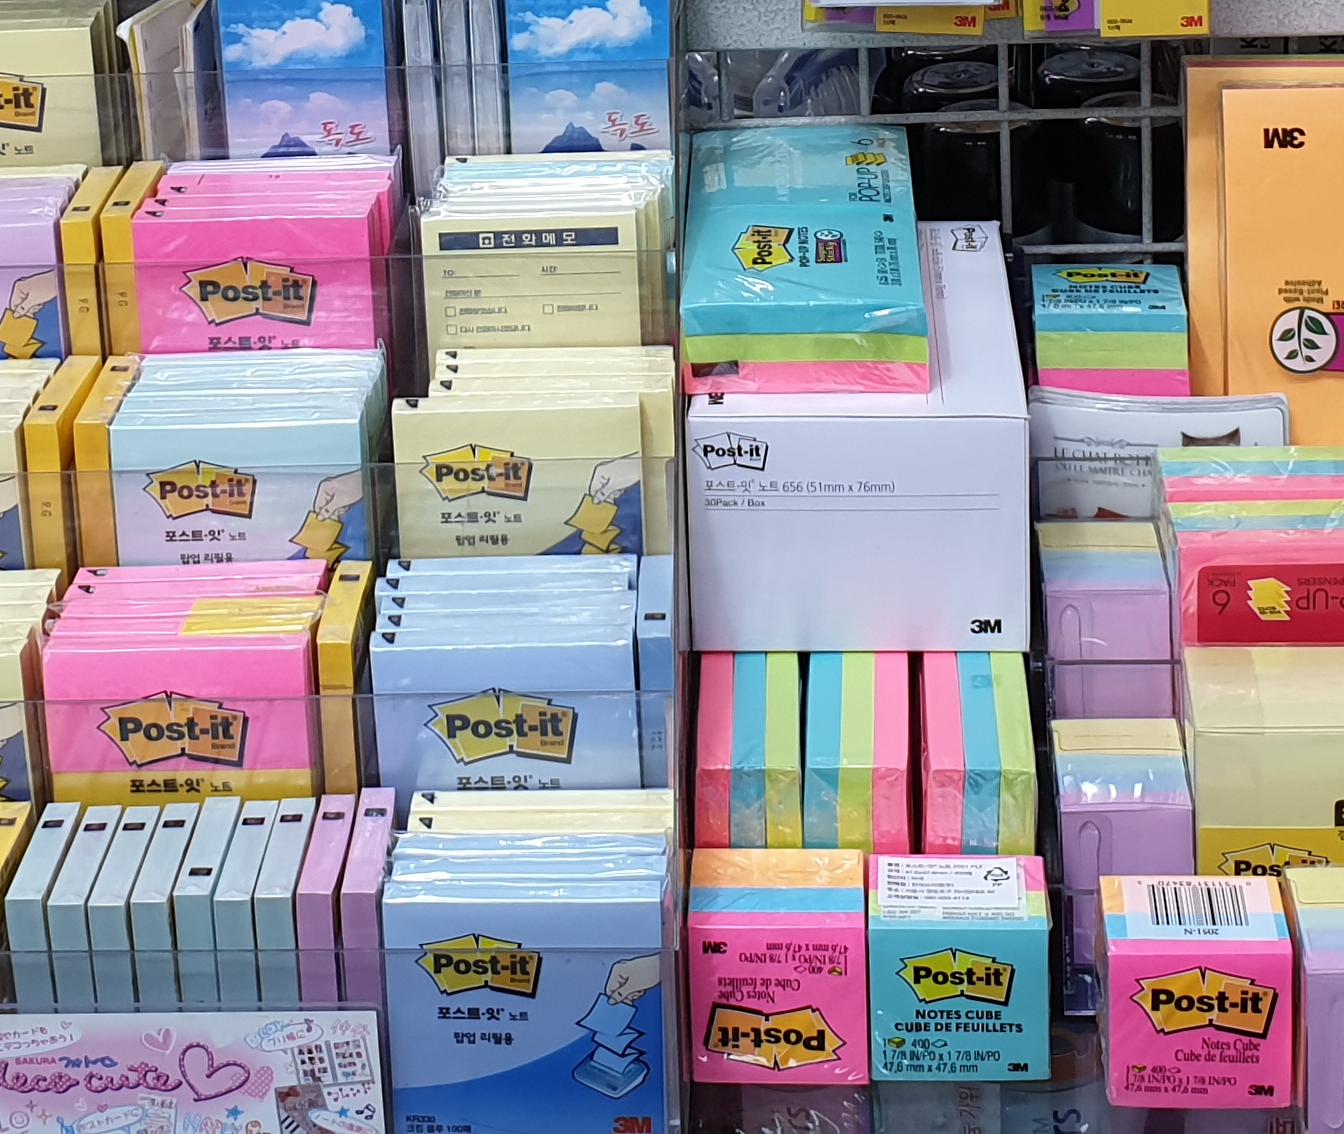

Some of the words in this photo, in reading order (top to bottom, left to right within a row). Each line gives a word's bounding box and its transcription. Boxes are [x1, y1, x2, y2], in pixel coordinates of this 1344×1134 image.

[602, 111, 658, 141] 독도
[319, 121, 375, 147] 독도
[1263, 127, 1306, 149] 3M
[14, 146, 34, 155] 노트
[502, 232, 576, 246] 전화메모
[758, 480, 779, 493] 노트
[782, 481, 803, 493] 656
[806, 480, 844, 494] (51mm
[848, 484, 854, 492] x
[856, 480, 895, 494] 76mm)
[509, 1011, 529, 1021] 노트
[916, 1010, 961, 1019] NOTES
[965, 1010, 1001, 1019] CUBE
[895, 1023, 930, 1031] CUBE
[935, 1023, 951, 1032] DE
[956, 1023, 1023, 1032] FEUILLETS
[454, 1032, 475, 1044] 팝업
[480, 1032, 514, 1045] 리필용
[1202, 1038, 1230, 1051] Notes
[1234, 1039, 1260, 1051] Cube
[15, 1057, 56, 1065] SAKURA
[892, 1051, 906, 1060] 7/8
[910, 1051, 935, 1060] IN/PO
[948, 1051, 951, 1060] 1
[956, 1051, 971, 1060] 7/8
[974, 1051, 1000, 1061] IN/PO
[1175, 1050, 1201, 1062] Cube
[1205, 1050, 1216, 1062] de
[1219, 1050, 1260, 1063] feuillets
[84, 1060, 182, 1094] cute
[1248, 1084, 1274, 1097] 3M
